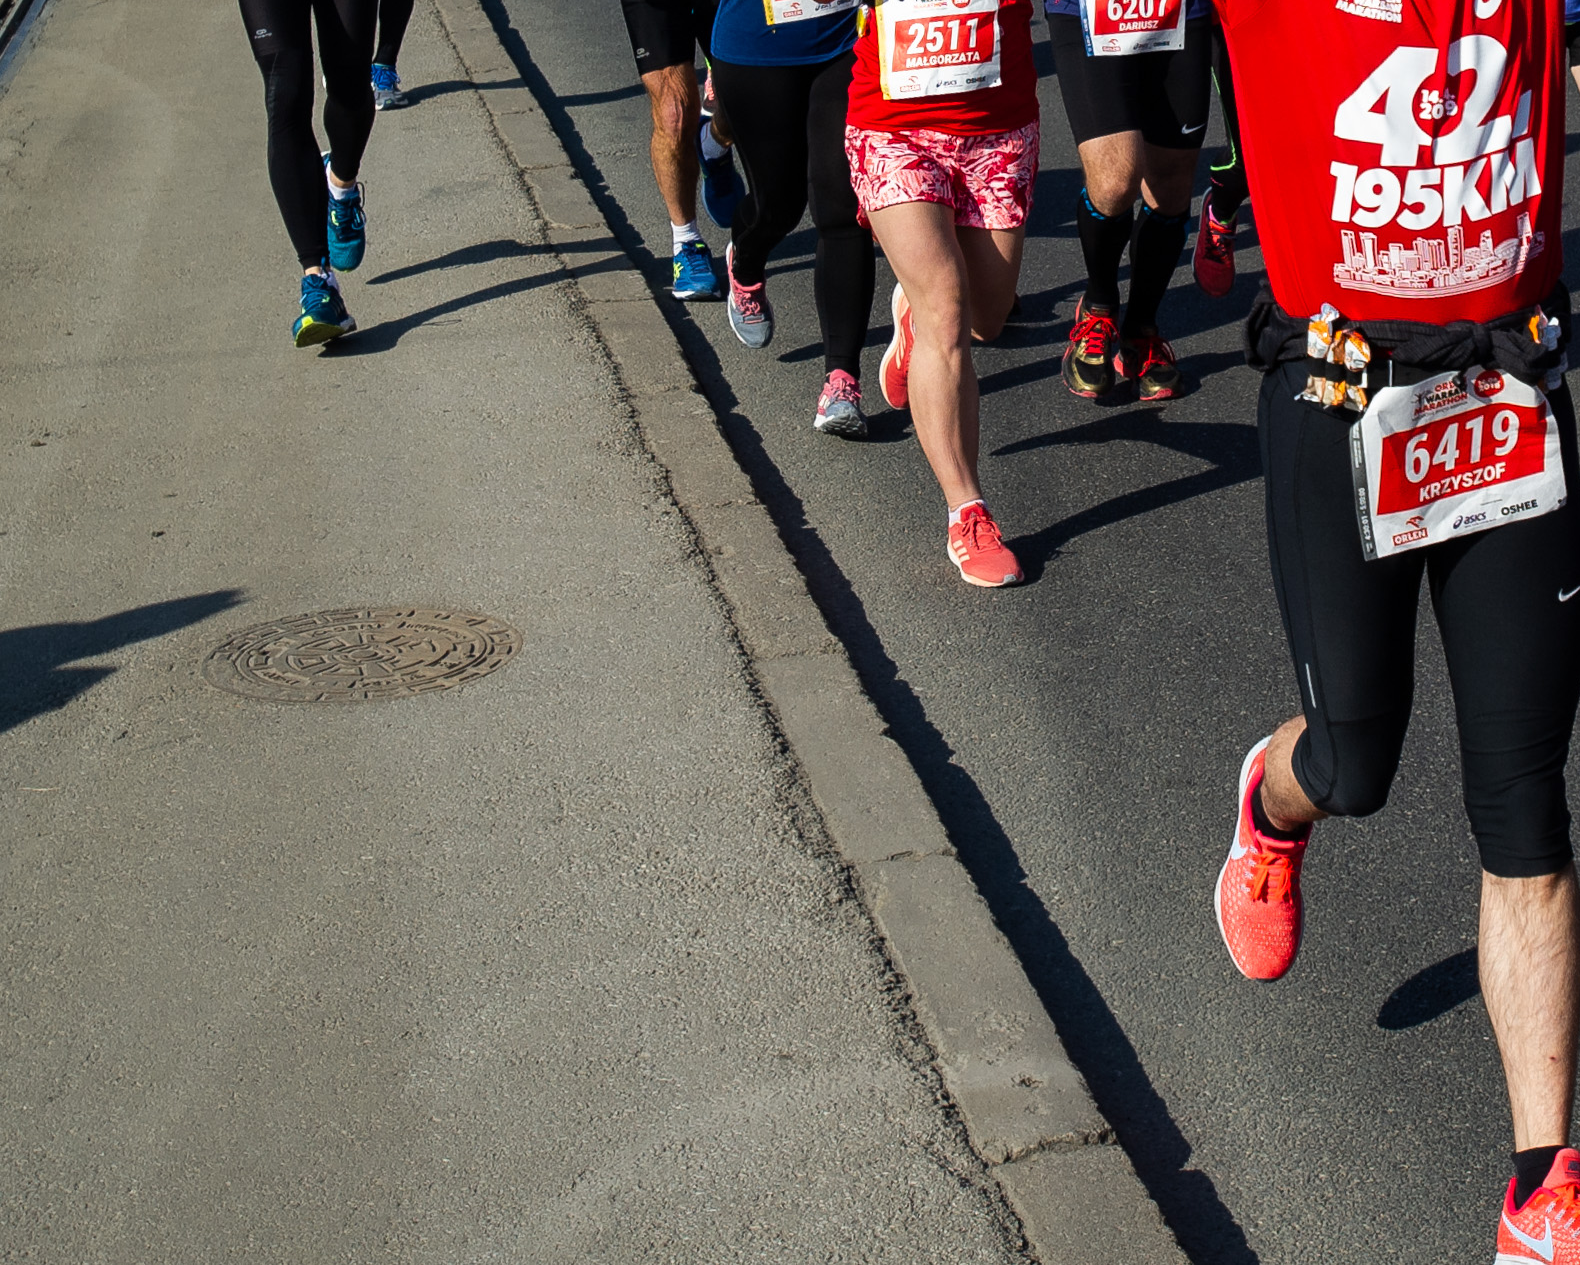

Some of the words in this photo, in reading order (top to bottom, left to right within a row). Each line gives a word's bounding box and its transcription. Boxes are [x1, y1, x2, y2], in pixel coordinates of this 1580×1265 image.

[1335, 0, 1403, 24] MARATHON
[906, 18, 979, 55] 2511
[1119, 20, 1159, 32] DARIUSZ
[906, 50, 981, 69] MAŁGORZATA
[1420, 99, 1458, 120] 209
[1330, 137, 1542, 230] 195KM
[1414, 392, 1468, 416] MARATHON
[1424, 388, 1460, 404] WARSA
[1404, 409, 1521, 484] 6419
[1418, 462, 1507, 503] KRZYSZOF
[1463, 511, 1487, 526] asics
[1501, 500, 1539, 516] OSHEE
[1394, 529, 1427, 546] ORLEN
